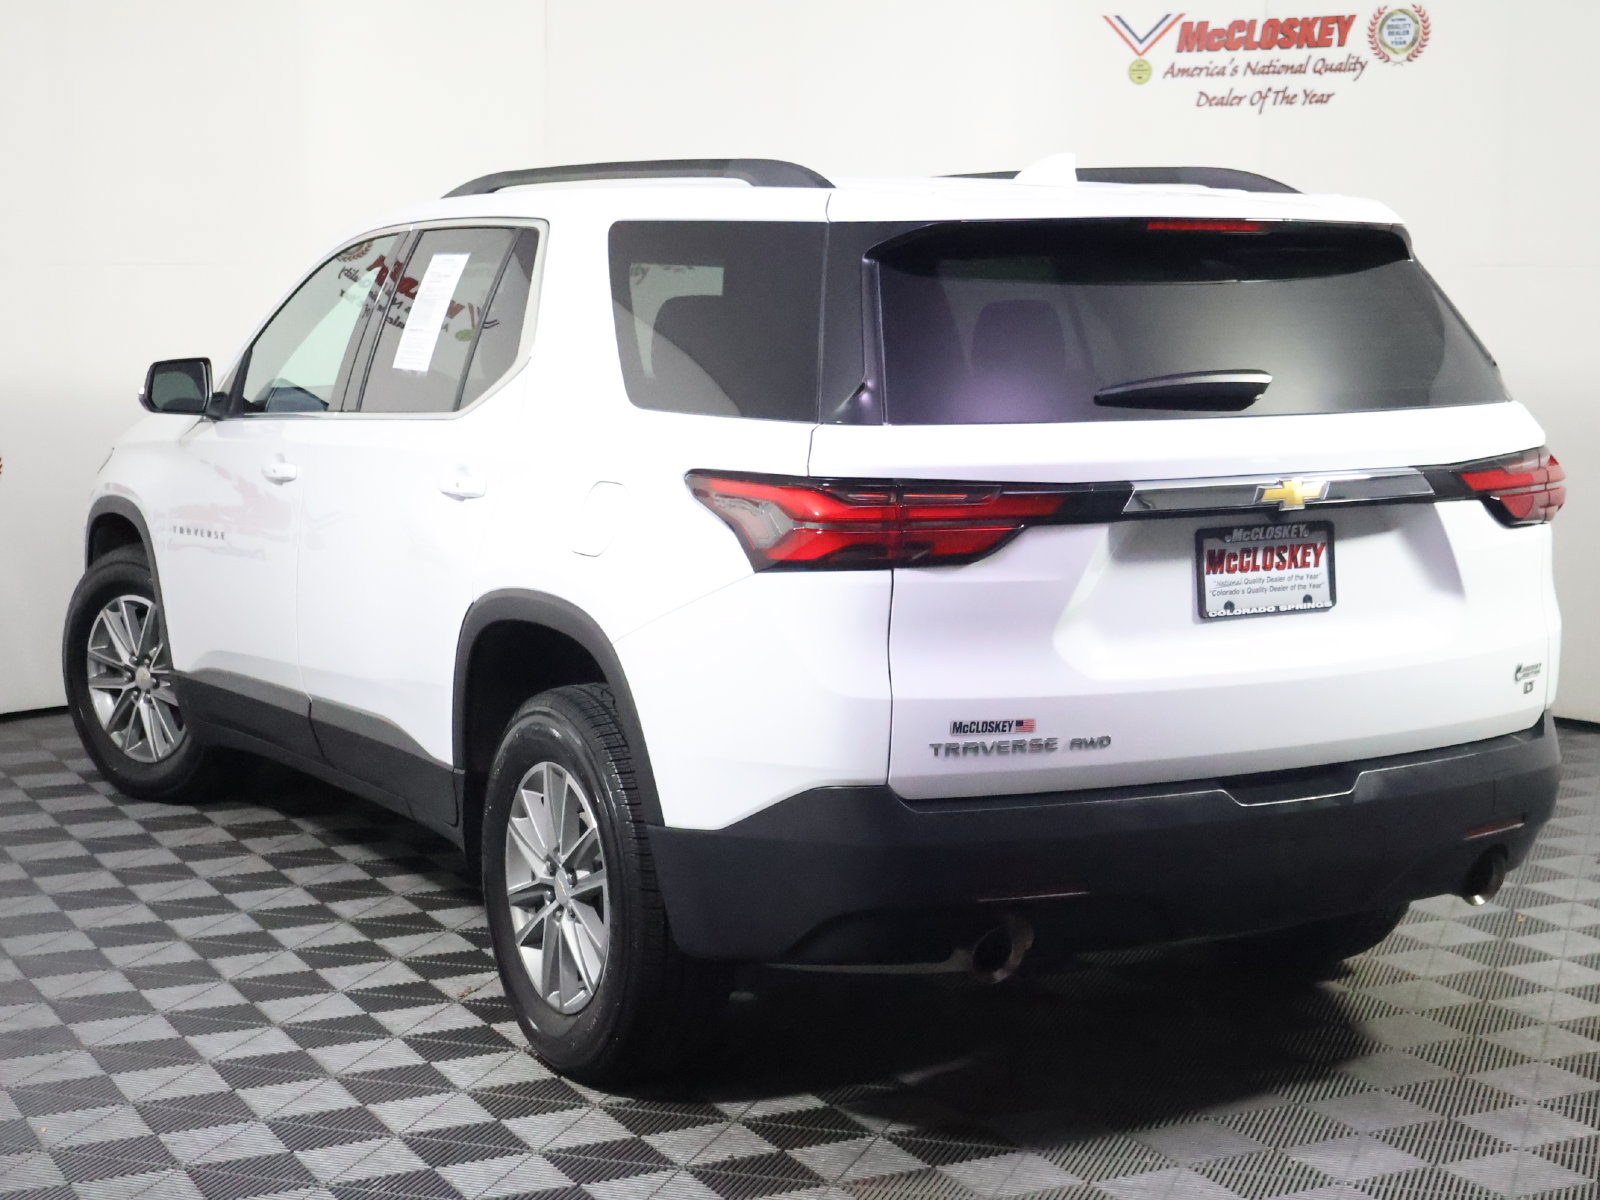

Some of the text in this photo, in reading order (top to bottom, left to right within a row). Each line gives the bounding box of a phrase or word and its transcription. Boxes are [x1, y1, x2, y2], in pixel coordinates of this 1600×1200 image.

[1176, 14, 1357, 53] McCLOSKEY
[1162, 57, 1239, 79] America's
[1245, 57, 1308, 76] National
[1312, 54, 1368, 82] Quality
[1196, 86, 1336, 115] Dealer Of The Year
[1231, 524, 1307, 541] McCLOSKEY
[1205, 543, 1326, 575] McCLOSKEY
[1244, 577, 1265, 586] Quality
[1266, 575, 1287, 583] Dealer
[1247, 587, 1268, 595] Quality
[1269, 584, 1290, 592] Dealer
[1290, 583, 1297, 591] of
[1297, 583, 1307, 591] the
[1208, 600, 1333, 618] COLORADO SPRINGS
[952, 719, 1014, 735] McCLOSKEY
[929, 735, 1112, 757] TRAVERSE AWD
